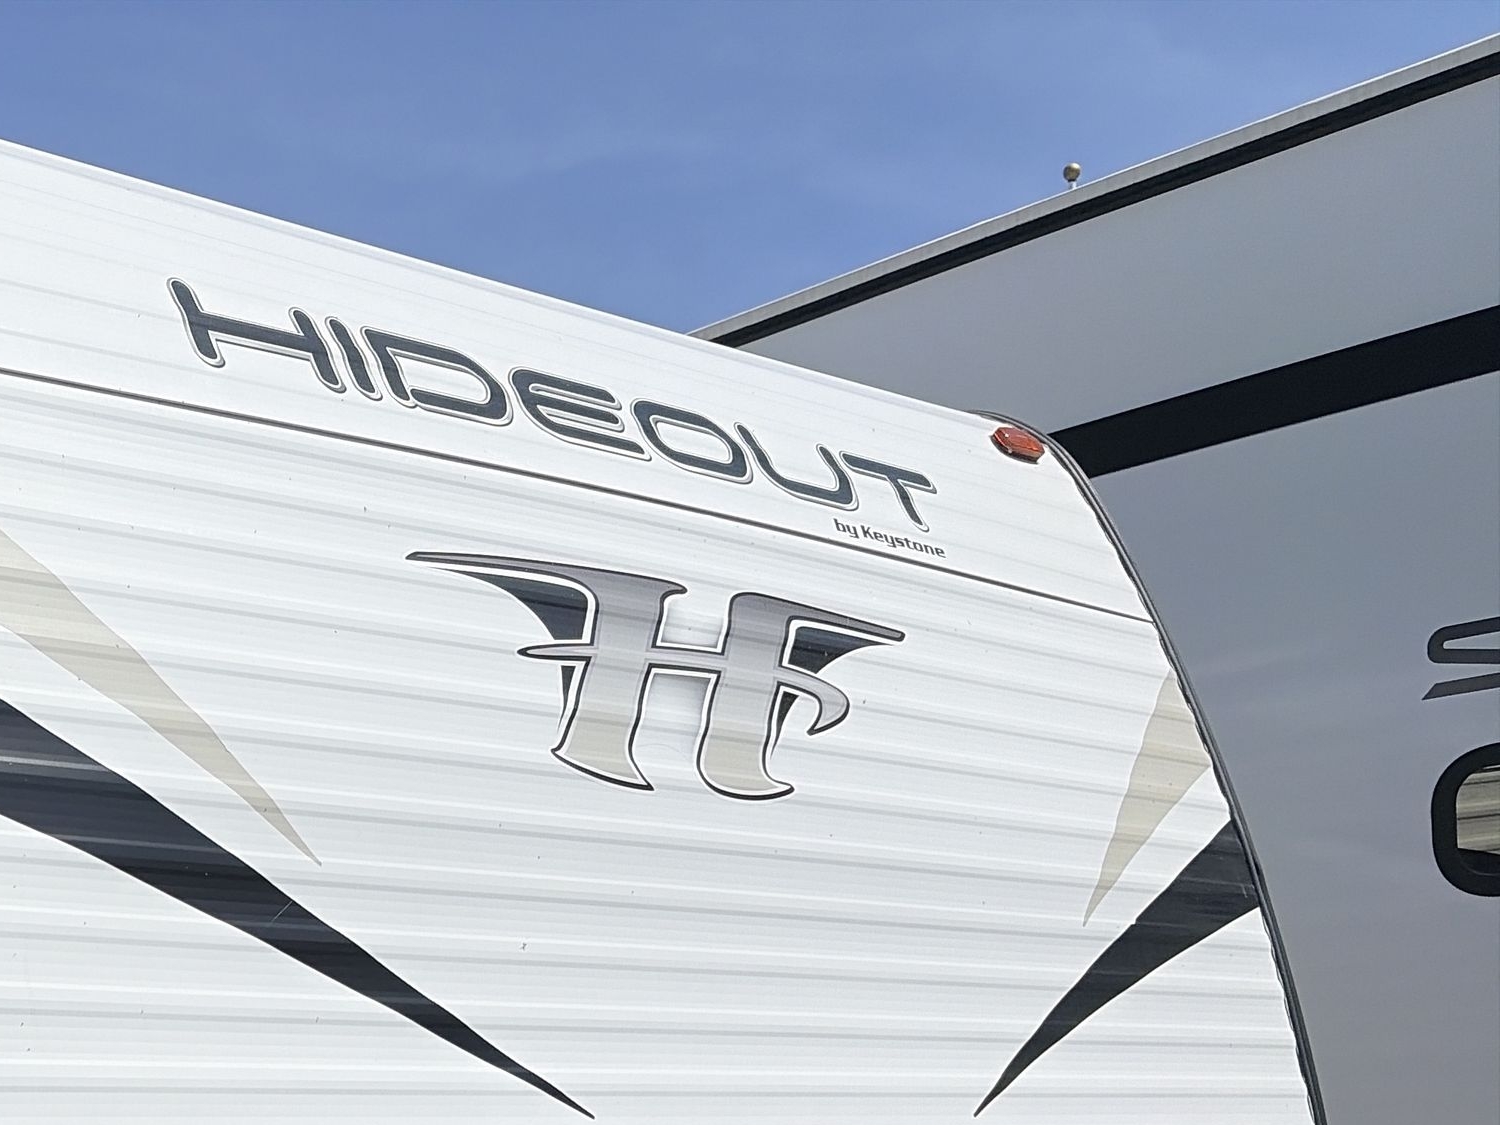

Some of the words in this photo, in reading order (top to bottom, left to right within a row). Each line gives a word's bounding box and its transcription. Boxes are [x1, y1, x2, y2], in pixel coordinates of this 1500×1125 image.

[167, 278, 937, 531] HIDEOUT
[833, 518, 860, 539] by
[860, 525, 947, 559] Keystone
